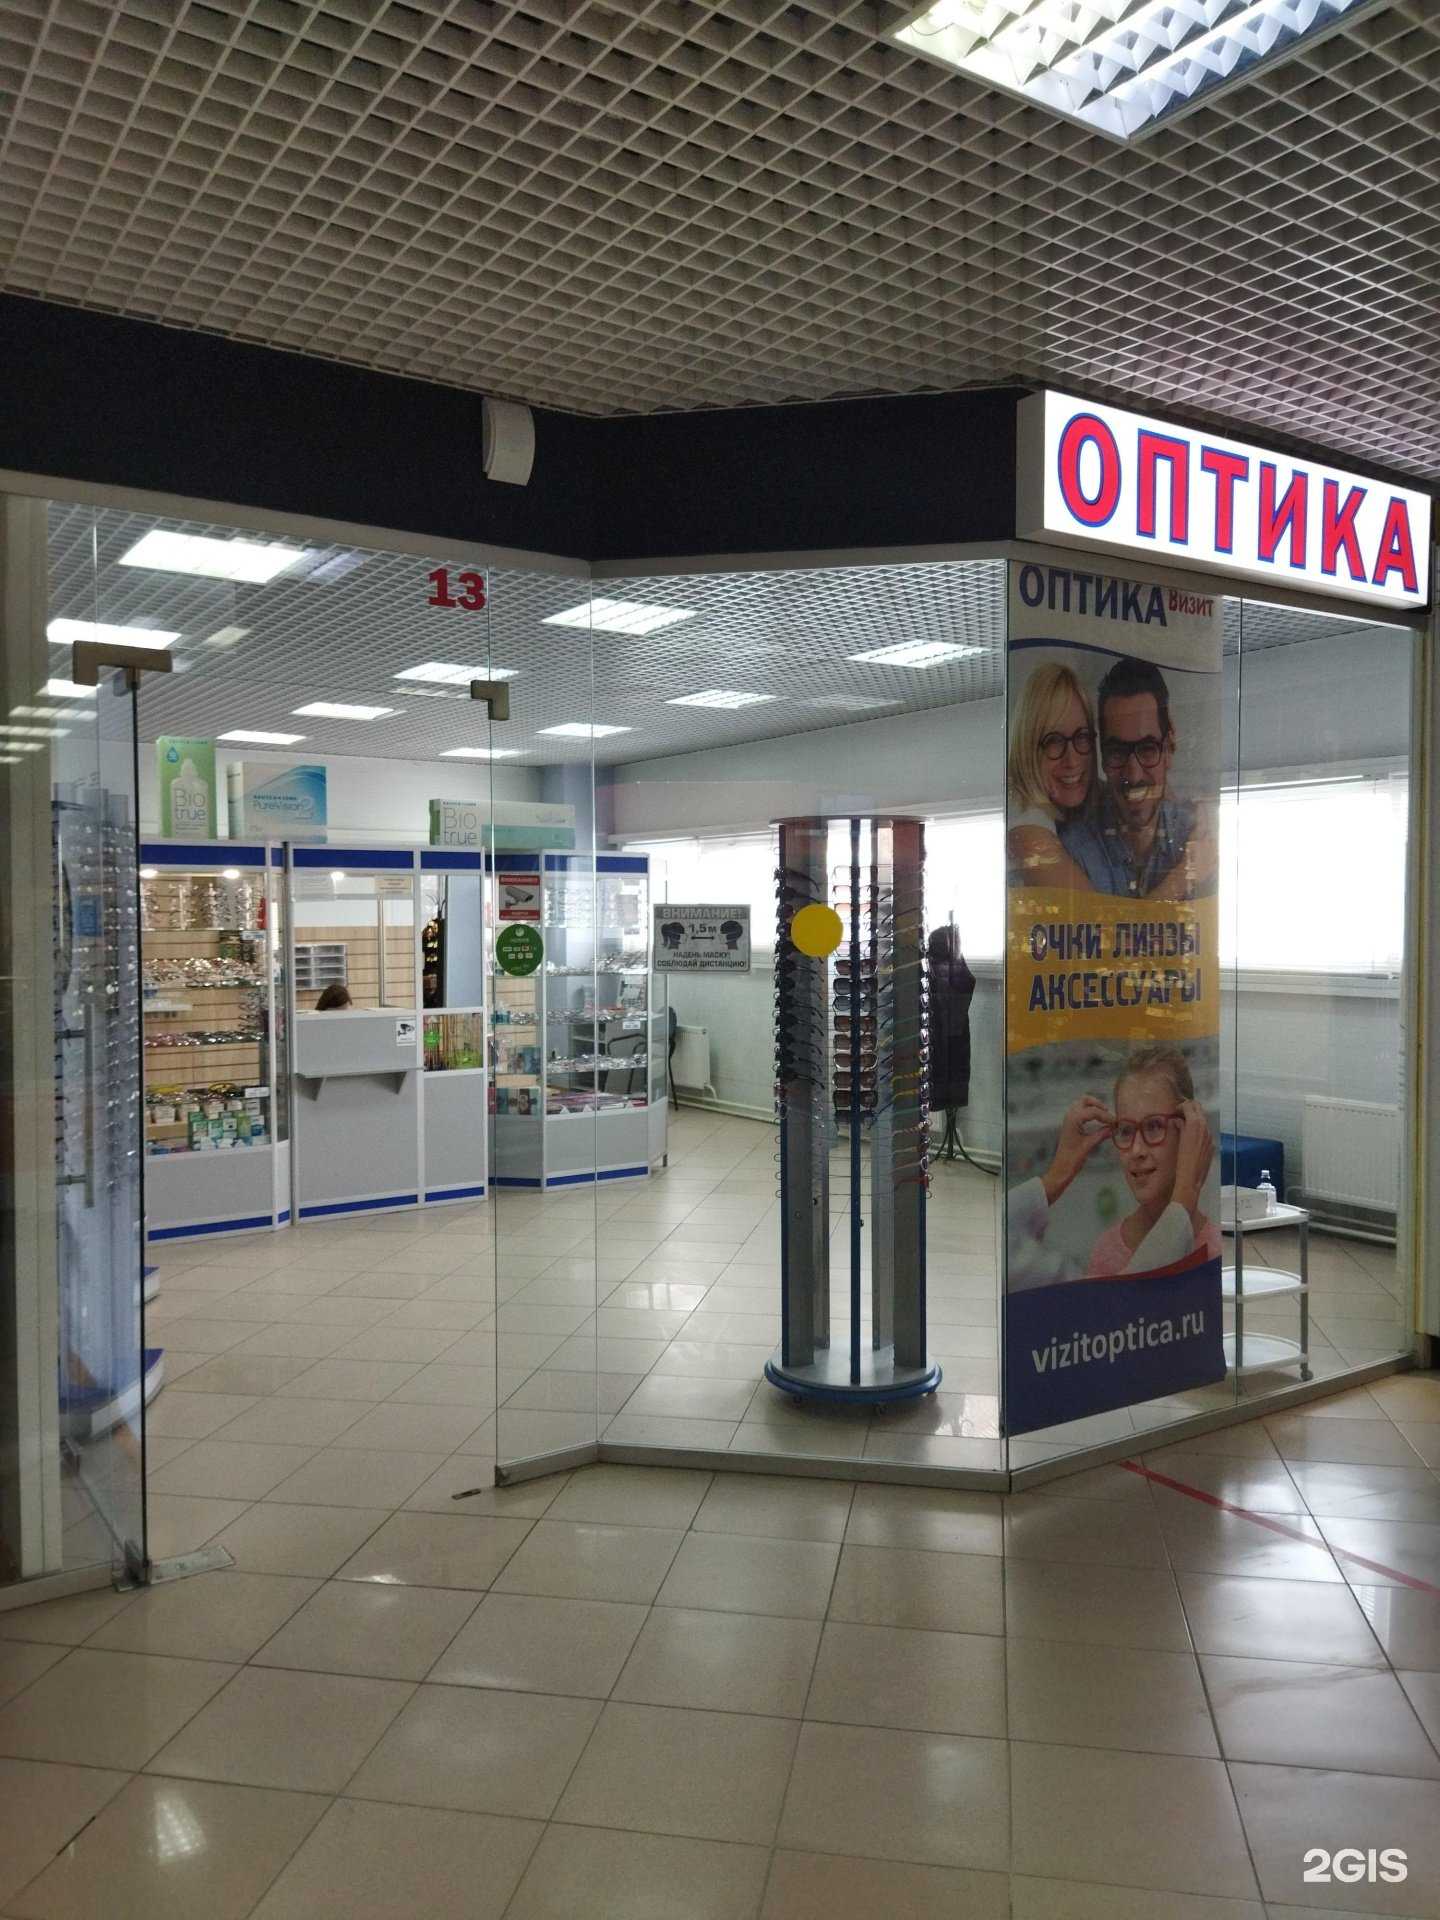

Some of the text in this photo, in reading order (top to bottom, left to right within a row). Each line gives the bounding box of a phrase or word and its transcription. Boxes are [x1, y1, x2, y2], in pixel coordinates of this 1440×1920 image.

[1057, 411, 1420, 594] ОПТИКА
[428, 568, 486, 611] 13
[1019, 564, 1168, 627] ОПТИКА
[689, 923, 707, 934] 1,5
[1031, 922, 1200, 962] ОЧКИ ЛИНЗЫ
[1028, 967, 1201, 1012] АКСЕССУАРЫ
[1032, 1310, 1204, 1373] vizitoptica.ru
